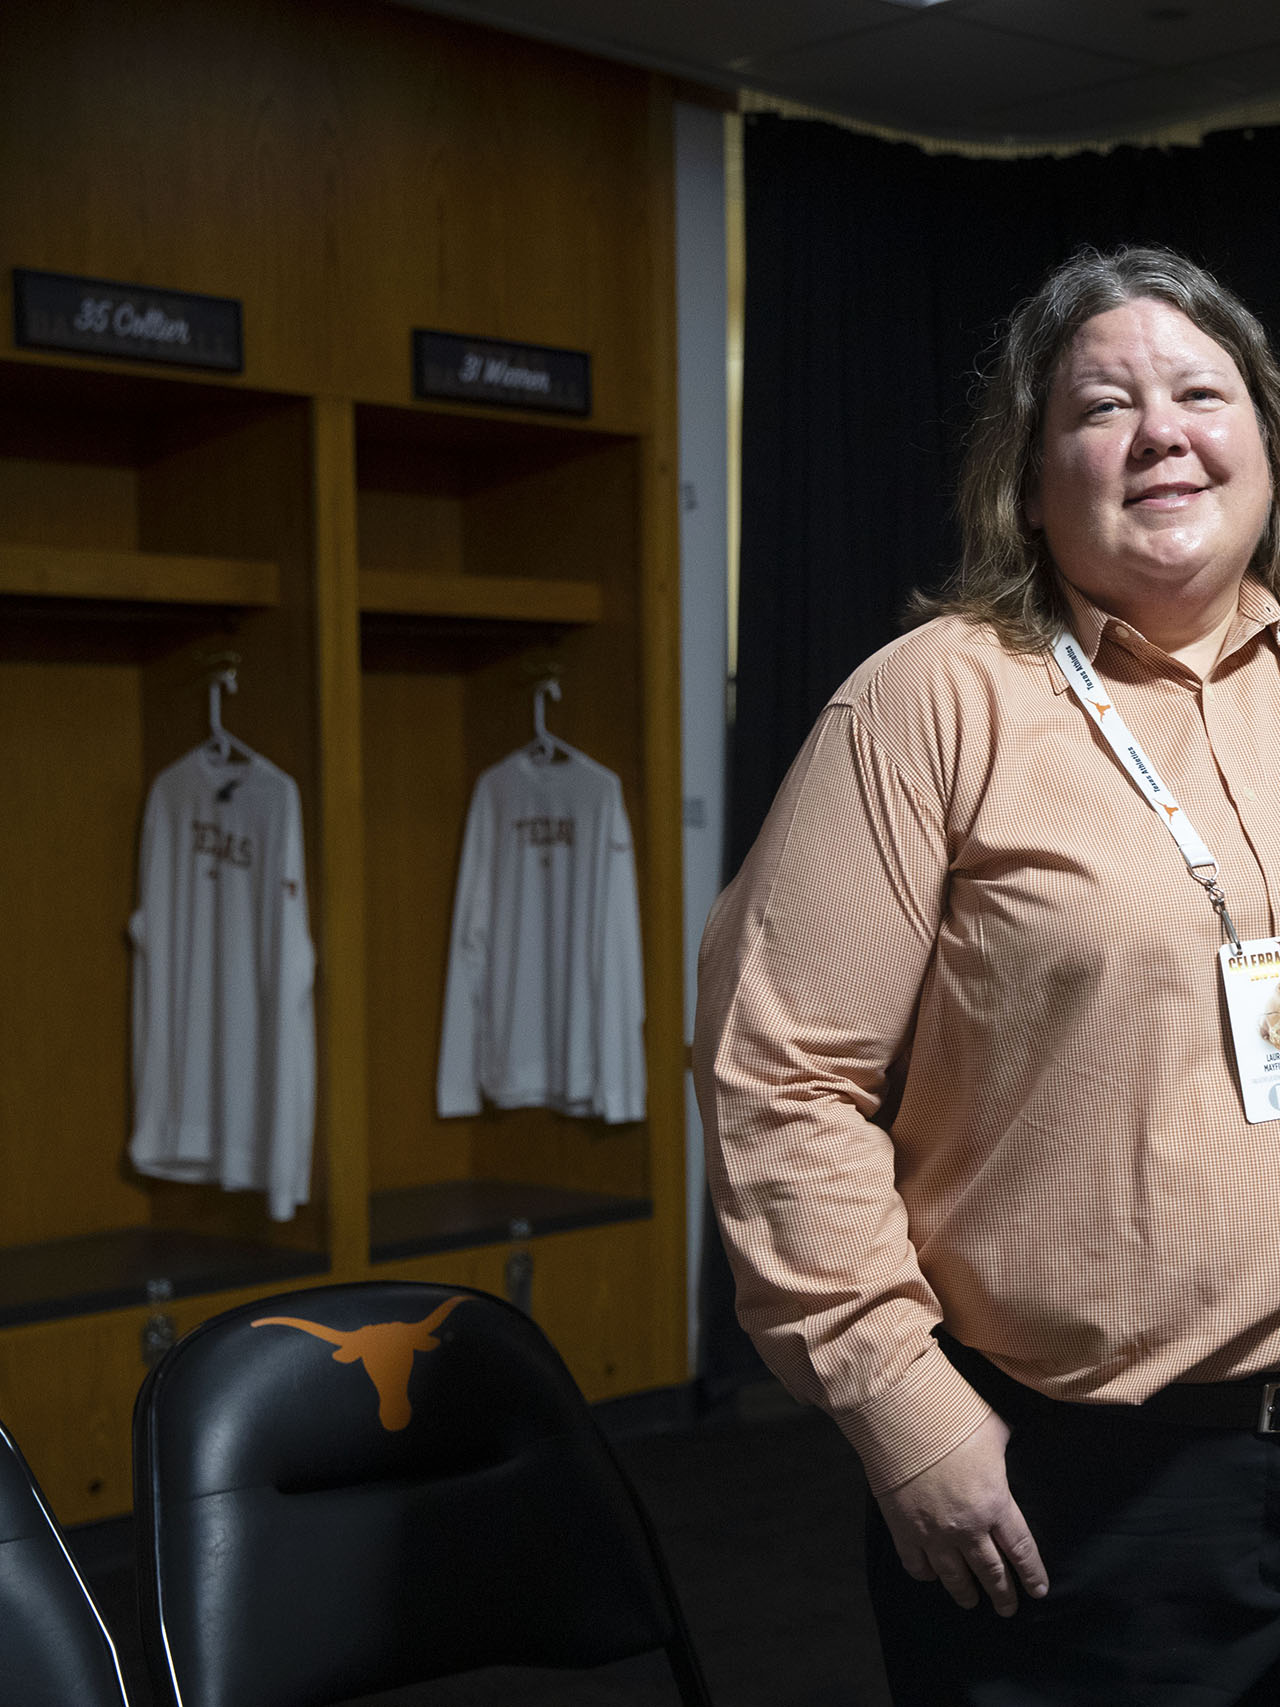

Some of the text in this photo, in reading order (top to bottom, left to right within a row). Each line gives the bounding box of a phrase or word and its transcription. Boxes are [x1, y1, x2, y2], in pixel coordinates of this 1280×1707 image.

[74, 297, 112, 332] 35
[1065, 645, 1094, 691] Texas Athletics
[1127, 746, 1161, 793] Texas Athletics
